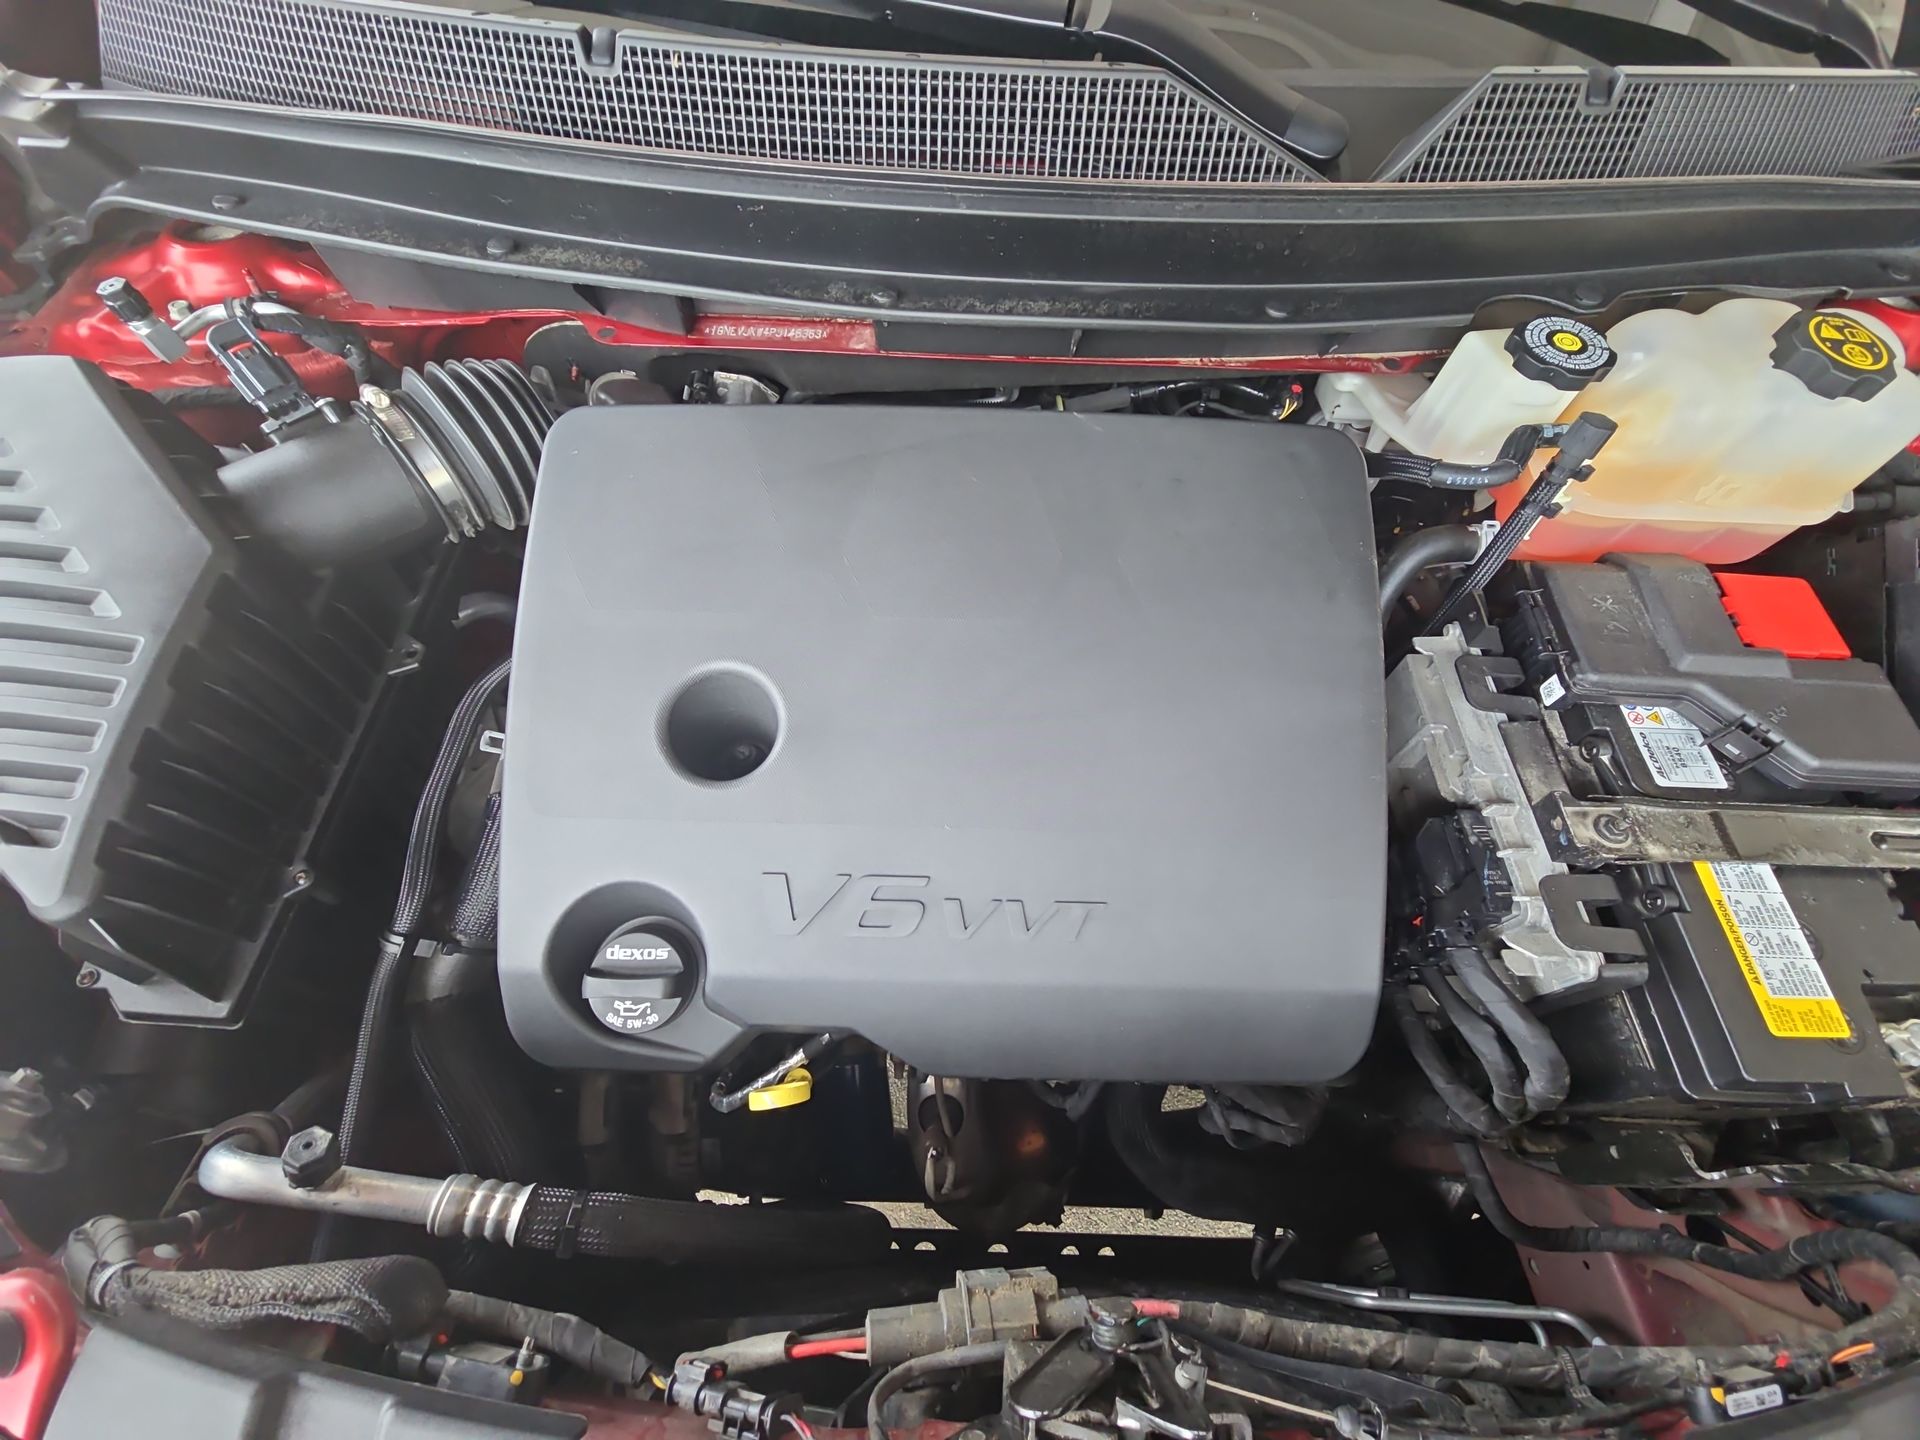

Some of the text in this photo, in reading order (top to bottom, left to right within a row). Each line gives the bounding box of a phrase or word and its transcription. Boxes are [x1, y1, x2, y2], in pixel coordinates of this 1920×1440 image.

[761, 871, 1109, 942] V6 VVT
[606, 944, 672, 961] dexos
[605, 1012, 659, 1030] SAE 5W-30
